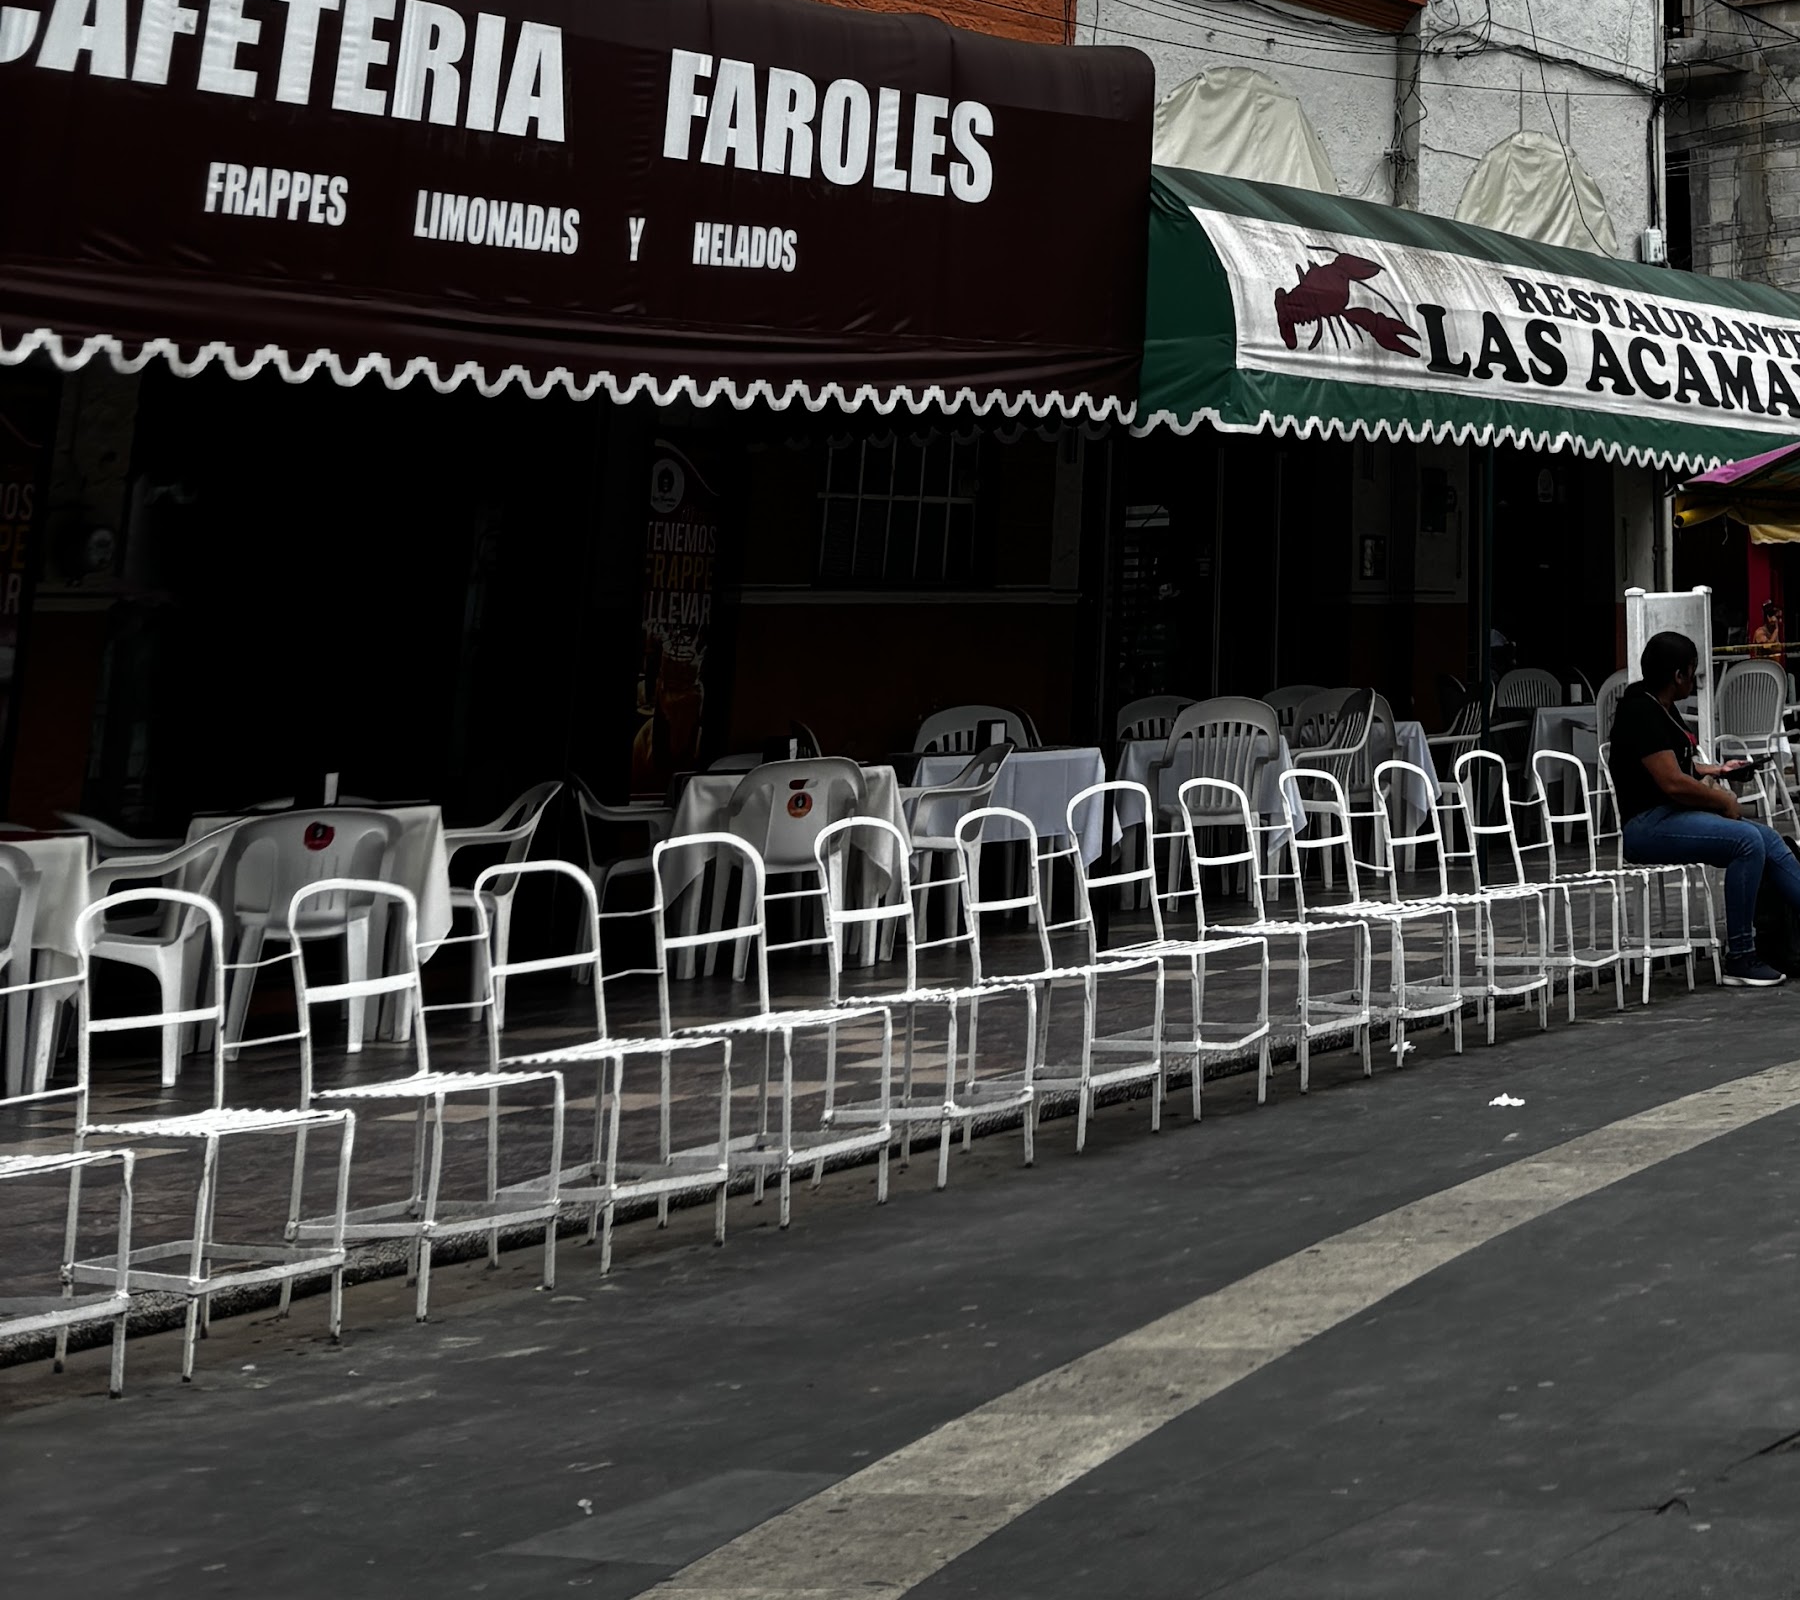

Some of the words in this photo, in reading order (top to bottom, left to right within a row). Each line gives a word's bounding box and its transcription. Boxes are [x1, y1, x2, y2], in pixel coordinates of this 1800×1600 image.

[663, 48, 994, 203] FAROLES
[204, 161, 349, 226] FRAPPES
[413, 189, 580, 255] LIMONADAS
[629, 217, 646, 262] Y
[692, 221, 798, 272] HELADOS
[1416, 303, 1568, 387] LAS
[646, 520, 718, 555] TENEMOS
